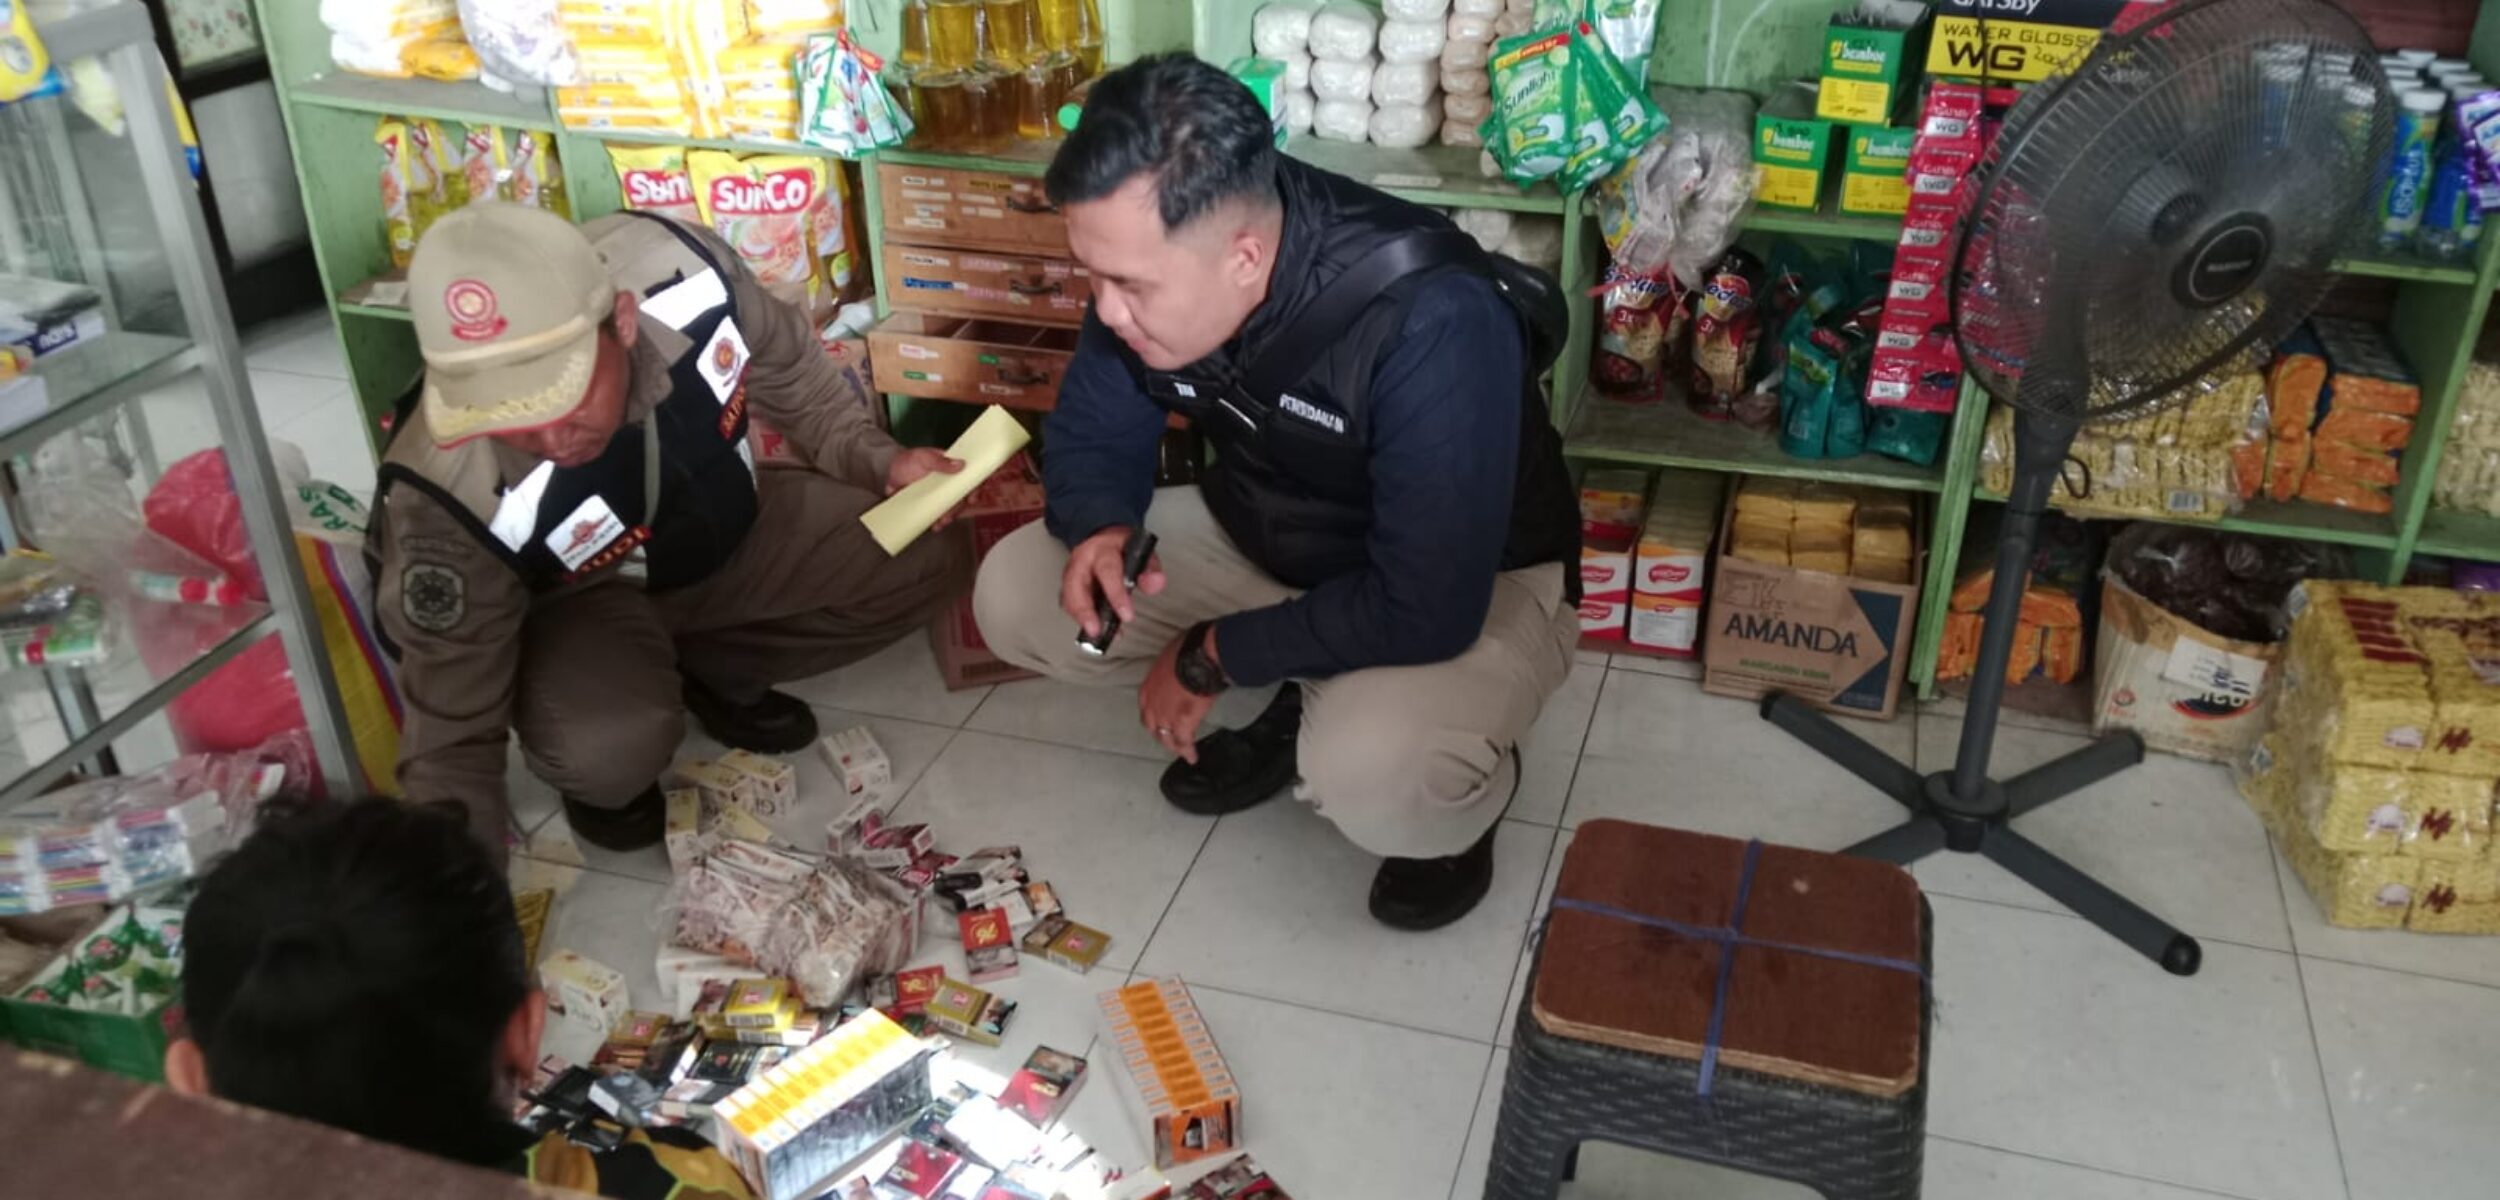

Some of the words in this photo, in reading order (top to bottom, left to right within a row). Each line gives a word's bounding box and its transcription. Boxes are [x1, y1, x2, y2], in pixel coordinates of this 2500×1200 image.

[1943, 23, 2011, 40] WATER
[1947, 39, 2027, 72] WG
[1503, 69, 1556, 114] Sunlight
[629, 172, 690, 202] Sun
[716, 174, 807, 211] SunCo
[1723, 612, 1859, 658] AMANDA
